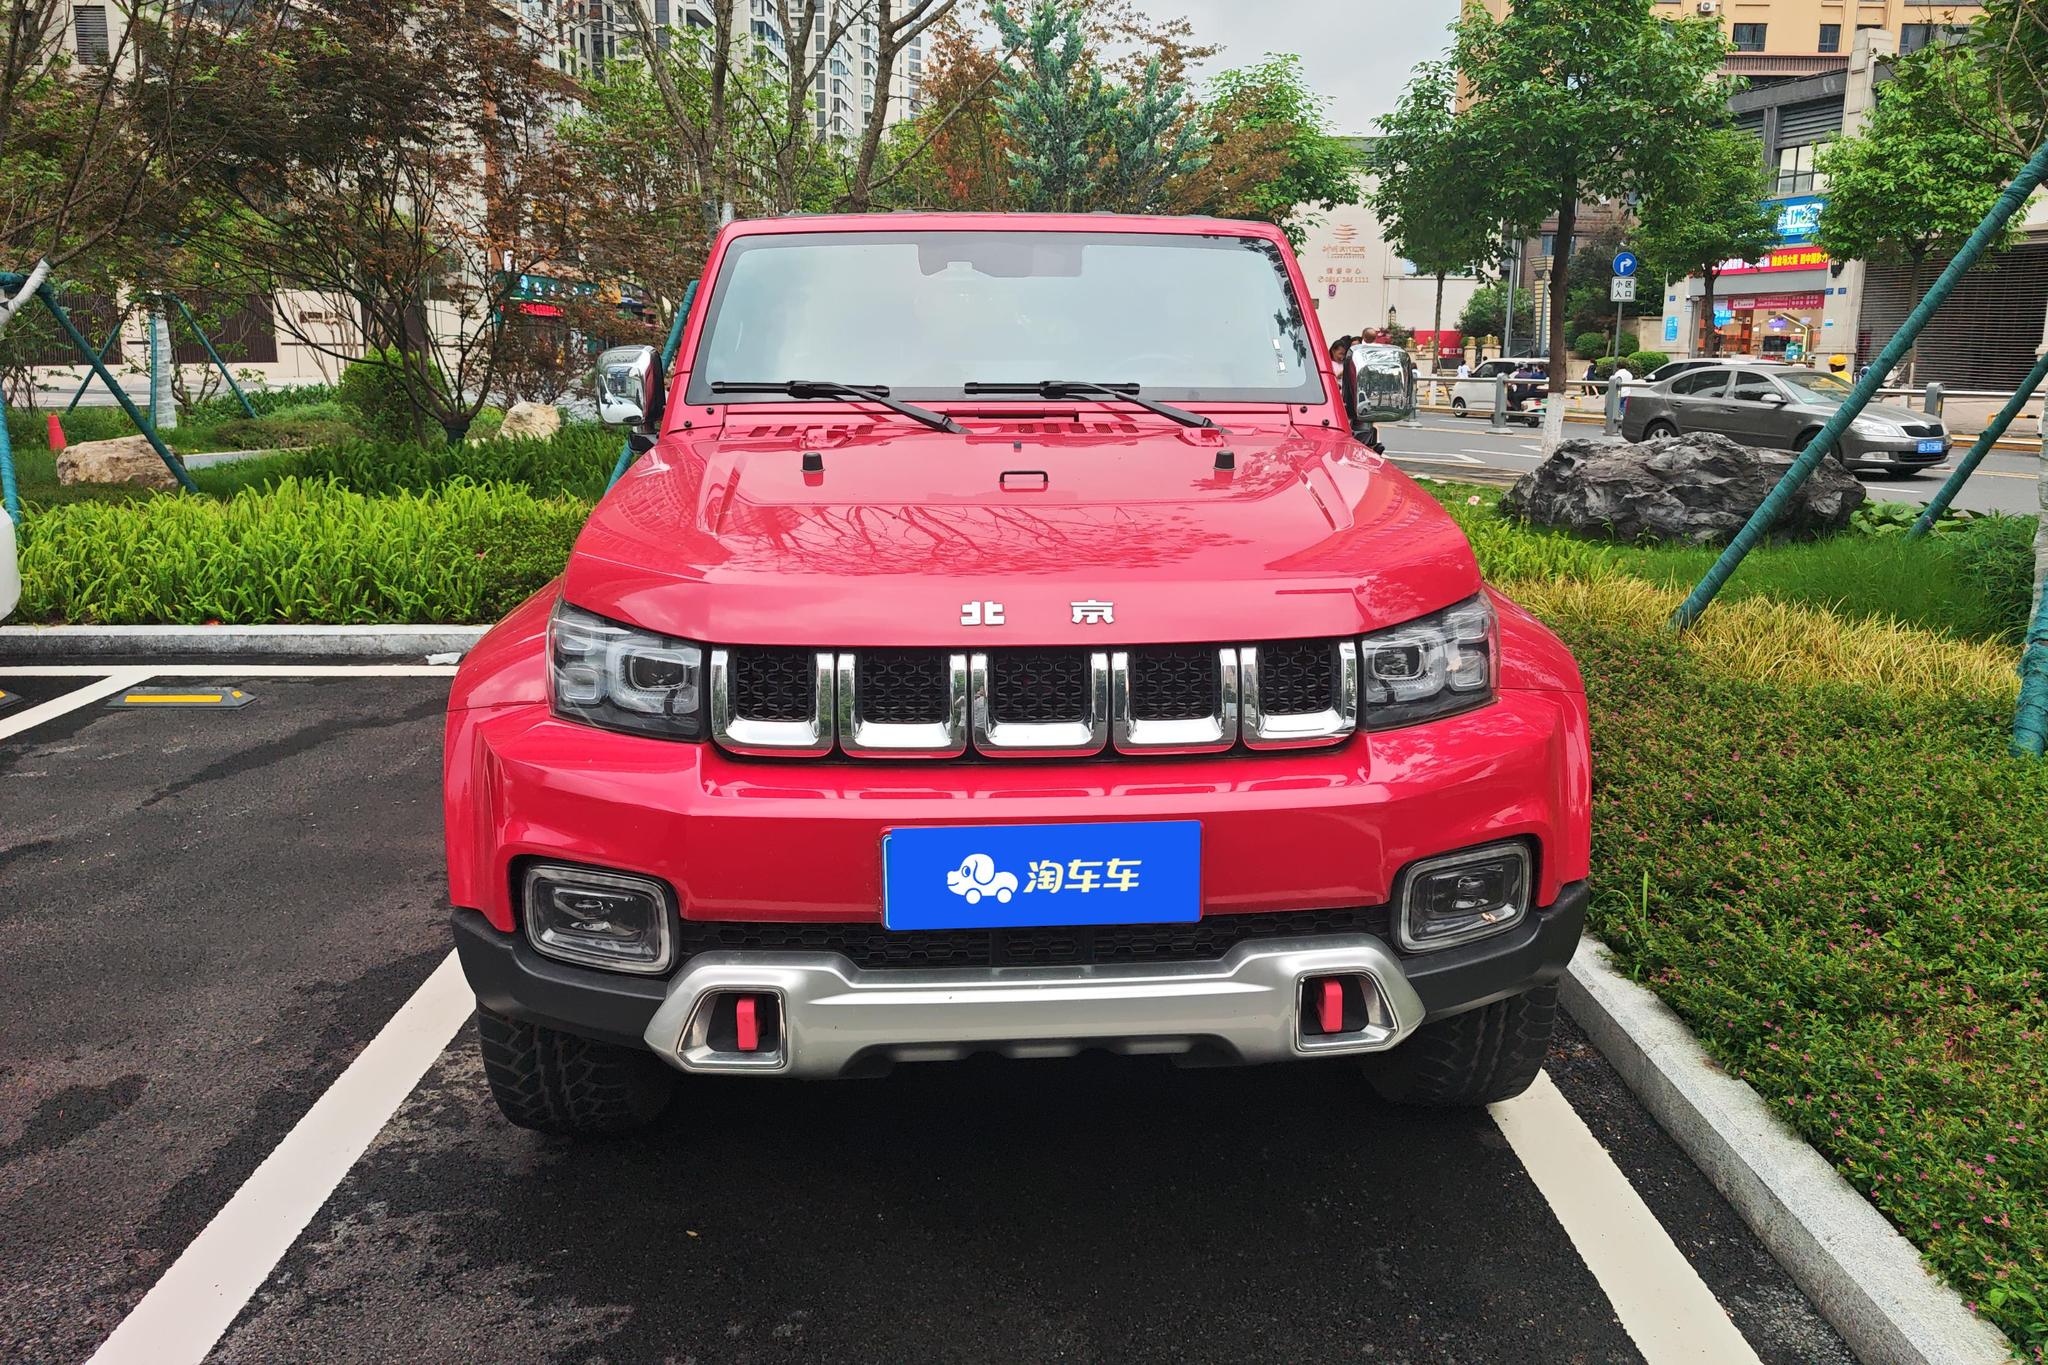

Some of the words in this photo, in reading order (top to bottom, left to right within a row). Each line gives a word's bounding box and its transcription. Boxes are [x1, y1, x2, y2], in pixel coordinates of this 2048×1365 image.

[1615, 280, 1632, 288] 小区
[1614, 290, 1632, 298] 入口
[960, 599, 1115, 626] 北京
